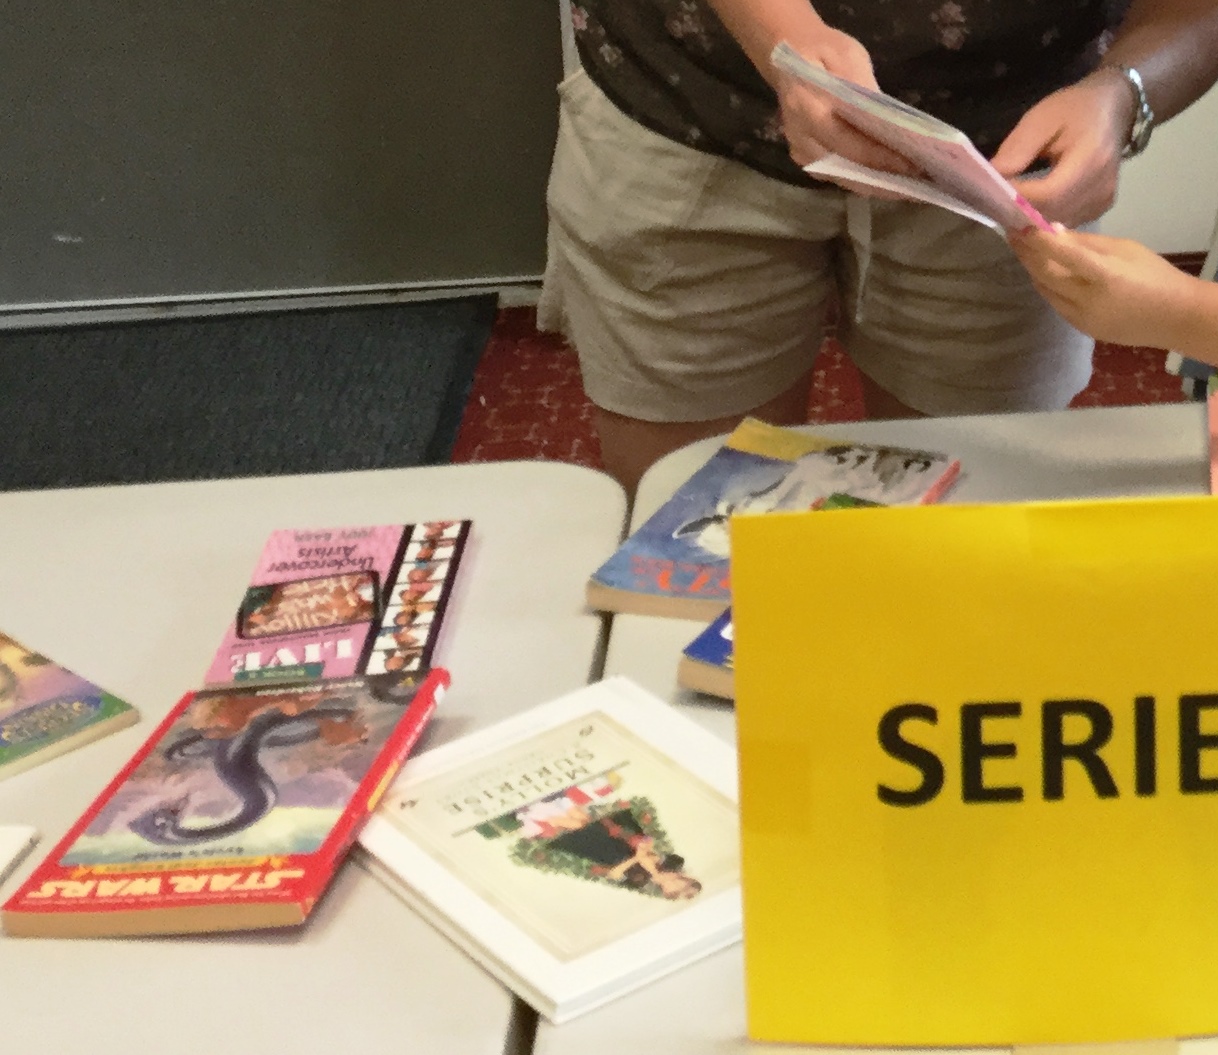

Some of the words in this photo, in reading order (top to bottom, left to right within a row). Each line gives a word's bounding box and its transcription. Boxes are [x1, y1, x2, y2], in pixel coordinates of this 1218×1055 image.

[297, 544, 358, 559] Artists
[267, 555, 376, 573] Undercover
[230, 638, 353, 674] LIVE
[25, 878, 163, 899] WARS
[167, 868, 306, 894] STAR
